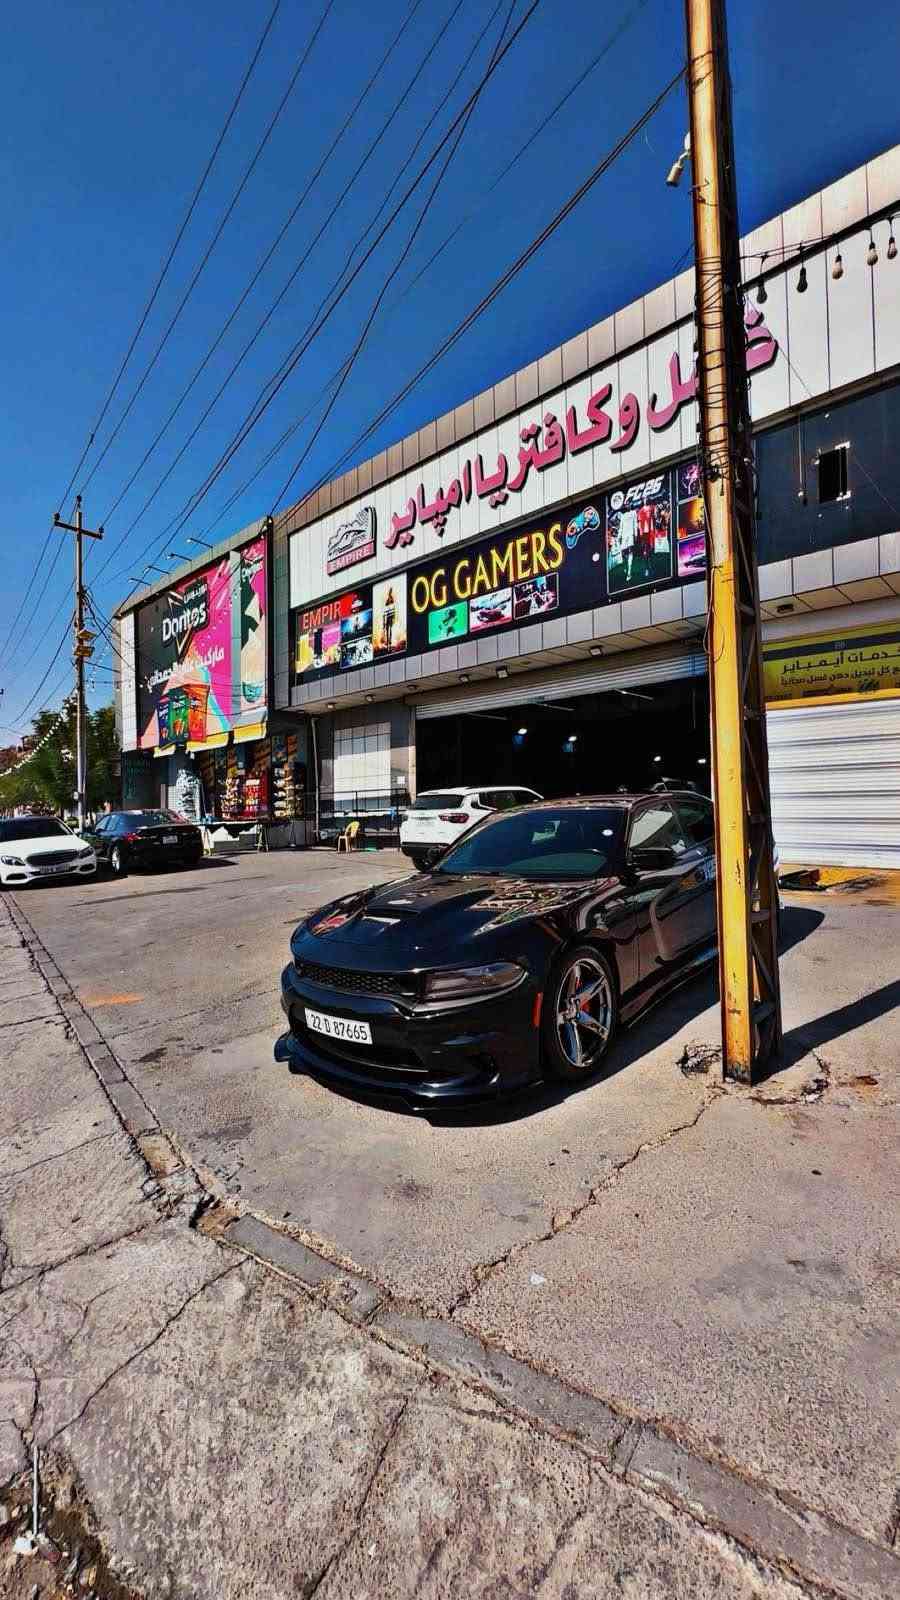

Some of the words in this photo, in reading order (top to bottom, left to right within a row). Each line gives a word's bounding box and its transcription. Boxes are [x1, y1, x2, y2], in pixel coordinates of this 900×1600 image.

[646, 302, 779, 433] غل
[328, 546, 371, 573] EMPIRE
[411, 568, 448, 614] OG
[453, 523, 565, 600] GAMERS
[847, 645, 900, 663] دمات
[310, 1014, 322, 1031] 22
[333, 1020, 368, 1041] 87665
